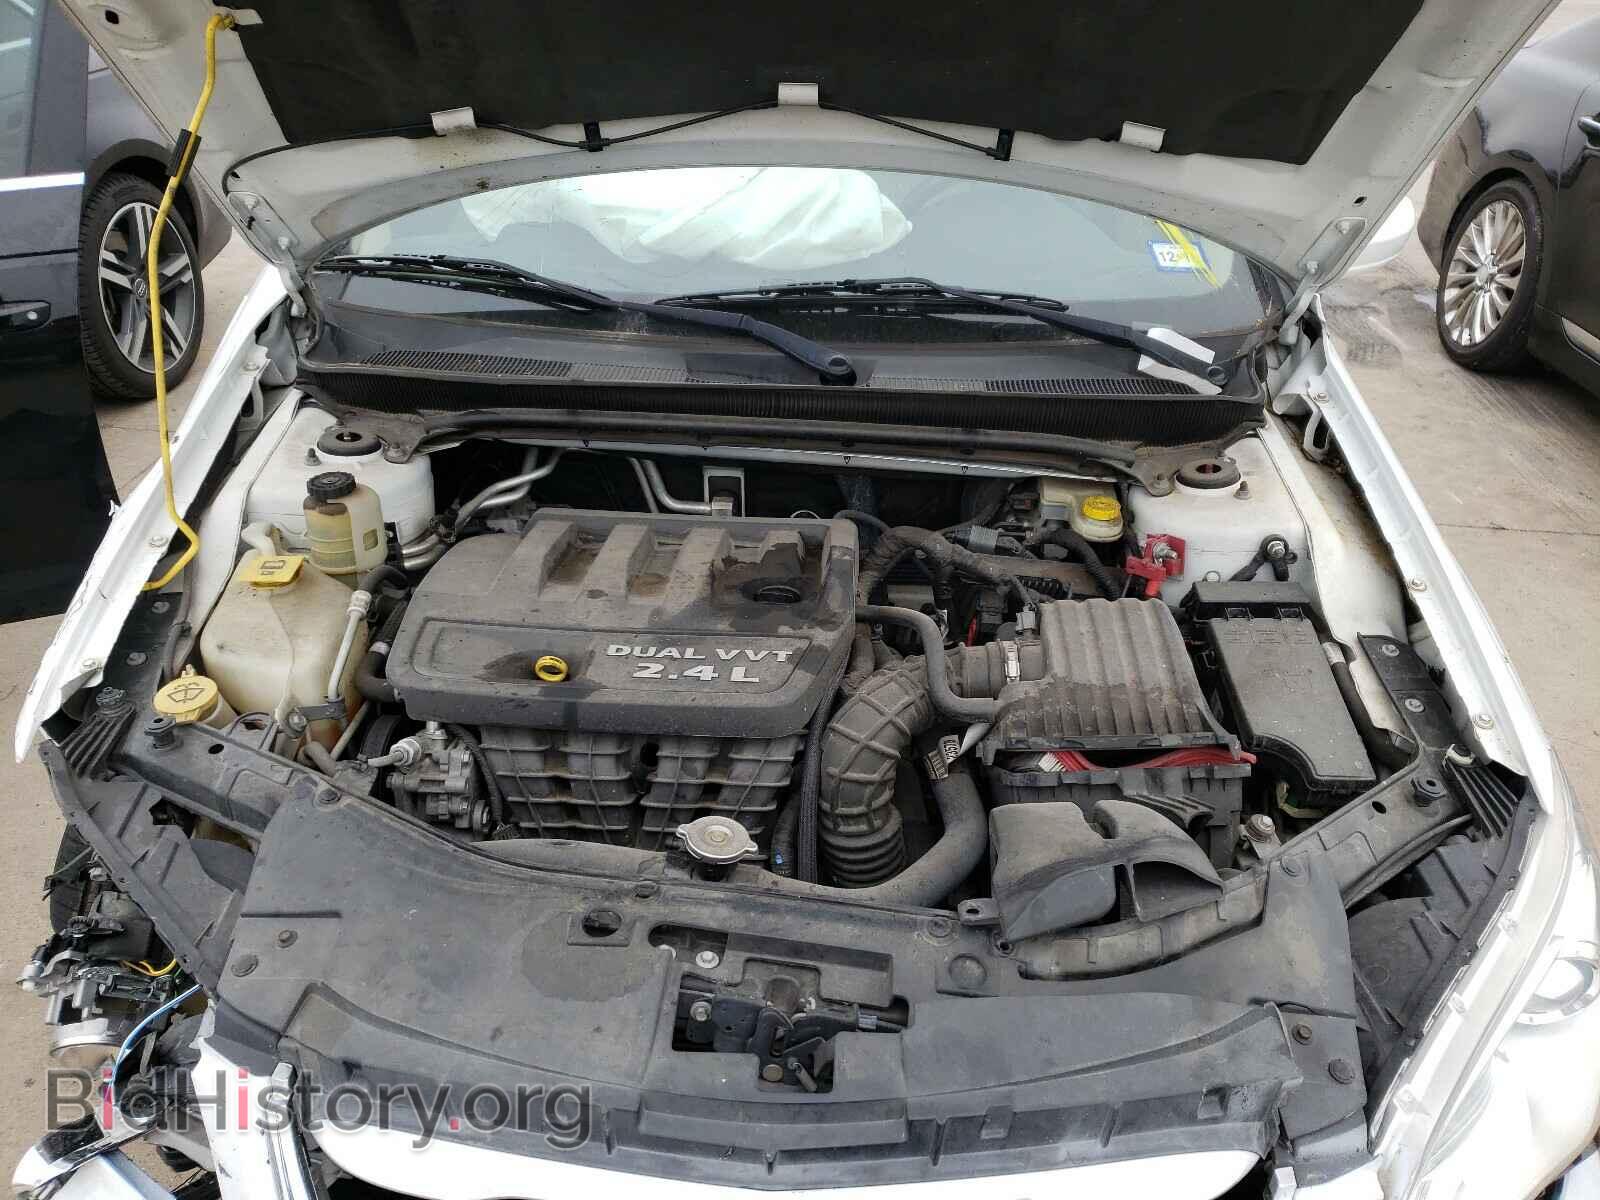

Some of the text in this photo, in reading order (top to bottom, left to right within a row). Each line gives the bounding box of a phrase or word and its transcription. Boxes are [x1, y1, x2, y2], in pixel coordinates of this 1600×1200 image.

[607, 644, 793, 662] DUAL VVT
[632, 662, 760, 682] 2.4 L
